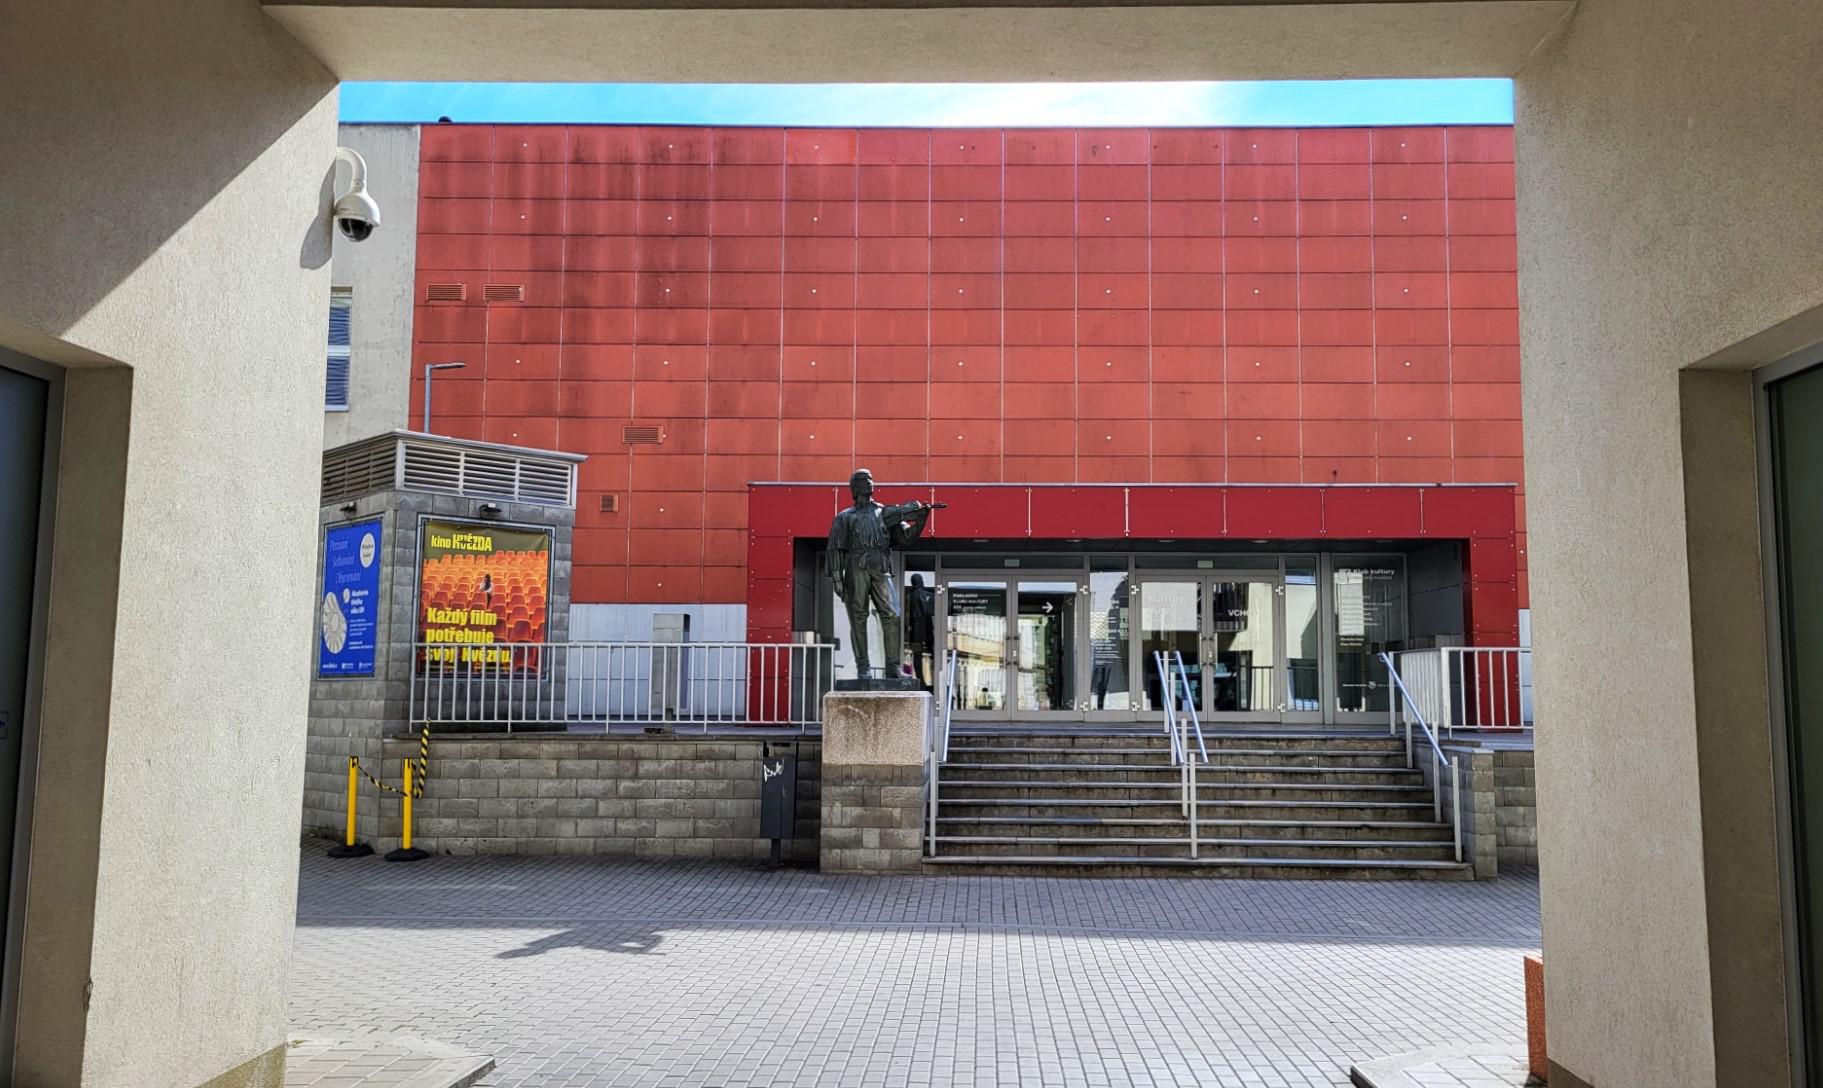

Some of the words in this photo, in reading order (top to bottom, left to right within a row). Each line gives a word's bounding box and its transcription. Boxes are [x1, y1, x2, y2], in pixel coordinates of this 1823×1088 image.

[431, 534, 451, 548] kino
[452, 532, 493, 552] HVĚZDA
[427, 606, 468, 626] Každý
[470, 608, 497, 626] film
[426, 627, 494, 644] potřebuje
[427, 647, 457, 663] svoj
